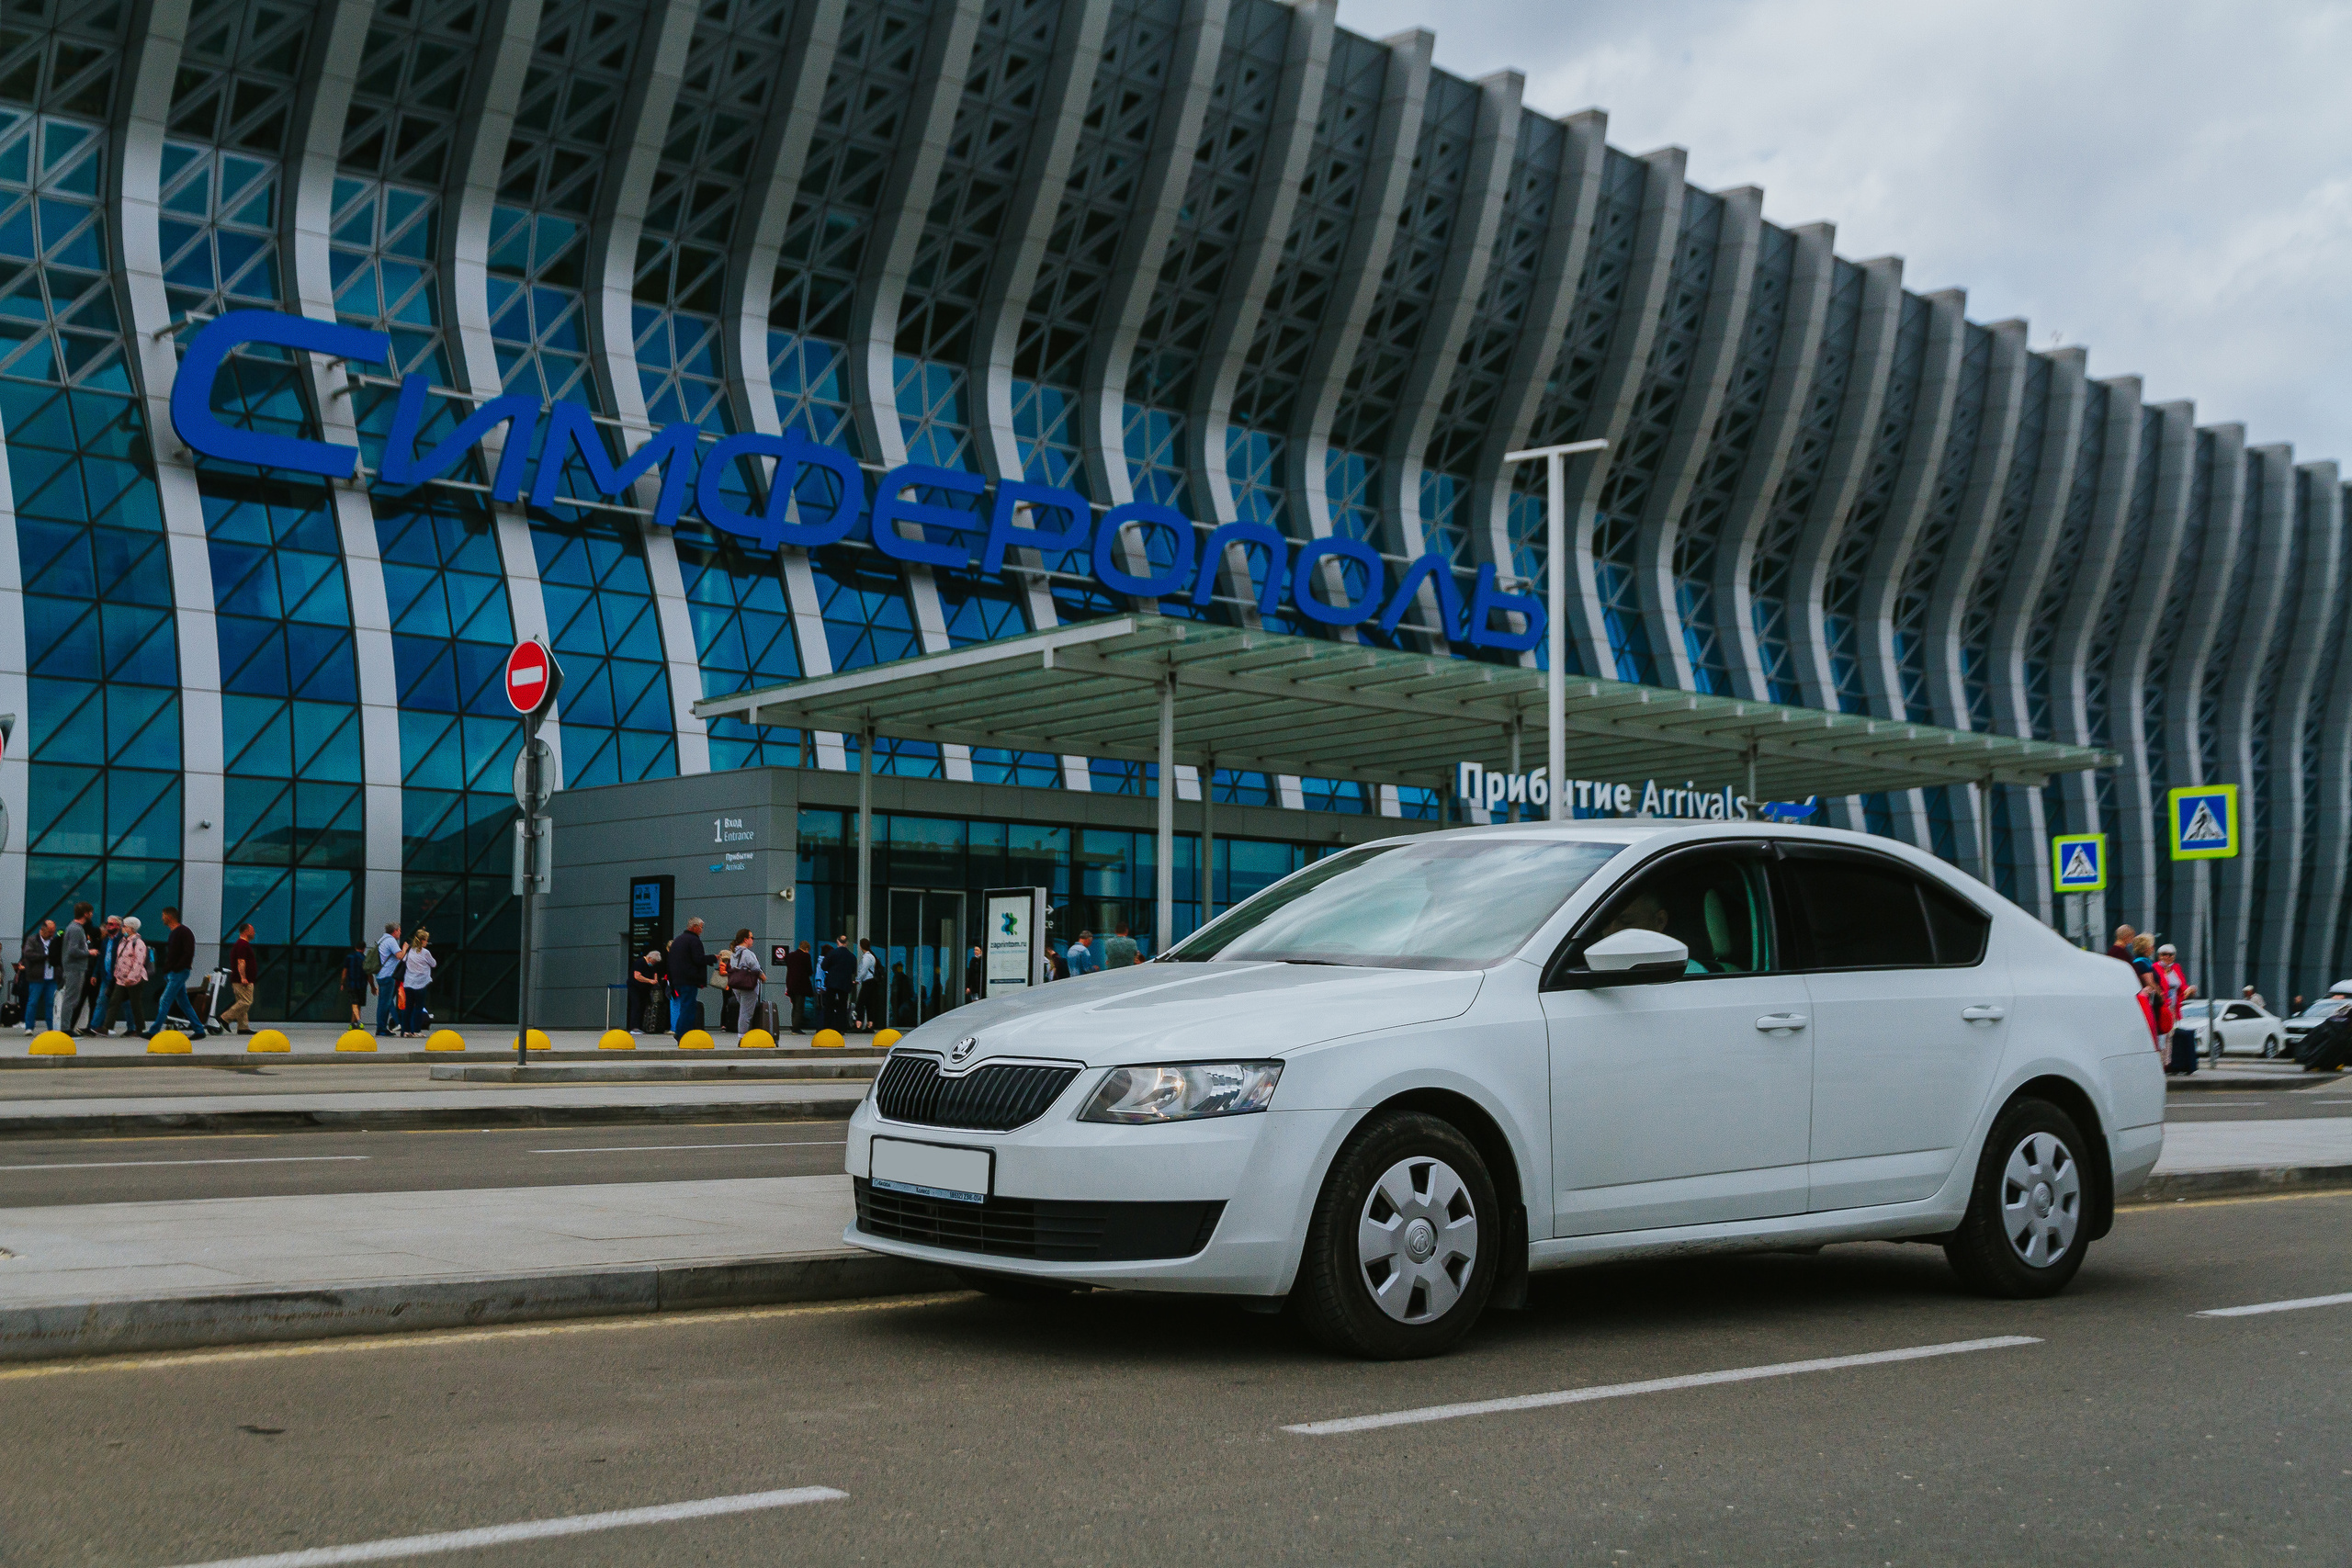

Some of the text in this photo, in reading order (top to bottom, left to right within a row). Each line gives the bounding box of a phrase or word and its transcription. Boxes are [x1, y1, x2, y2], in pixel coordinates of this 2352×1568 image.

[1640, 778, 1749, 821] Arrivals
[724, 818, 742, 828] Вход
[714, 818, 722, 842] 1
[724, 831, 754, 841] Entrance
[725, 862, 745, 871] Arrivals
[990, 940, 1027, 949] zaprintom.ru
